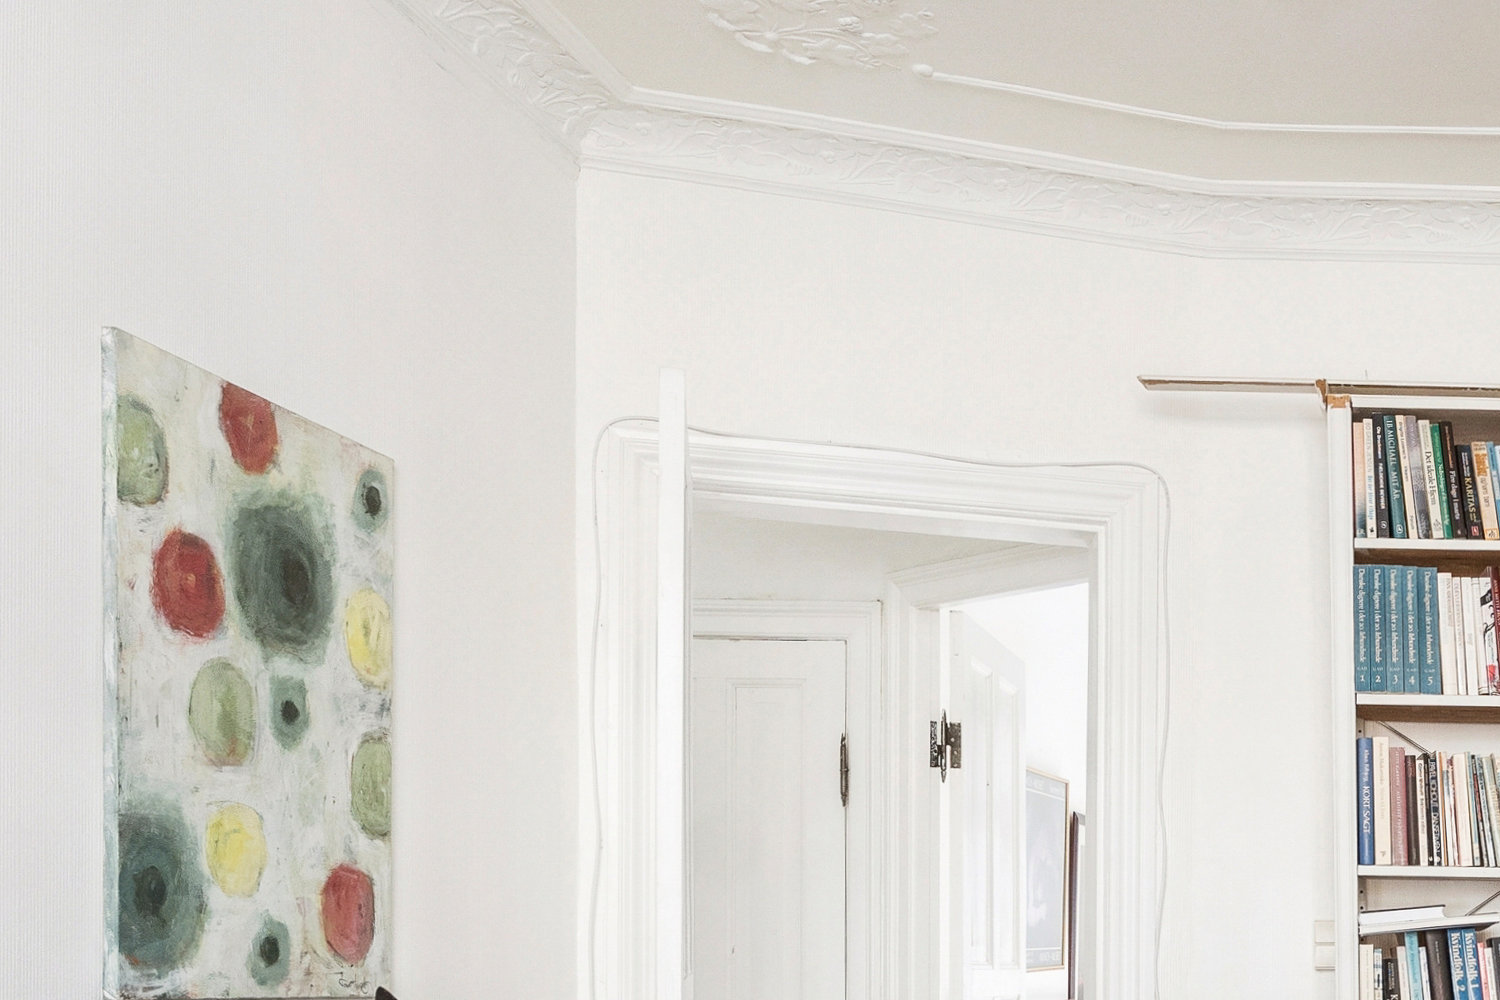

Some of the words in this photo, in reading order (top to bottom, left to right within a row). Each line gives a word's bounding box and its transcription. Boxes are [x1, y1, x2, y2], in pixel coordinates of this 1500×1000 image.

[1386, 420, 1392, 428] IB
[1387, 430, 1397, 465] MICHAEL
[1465, 478, 1476, 512] KARITAS
[1451, 932, 1464, 980] Kvindfolk
[1465, 932, 1479, 980] Kvindfolk
